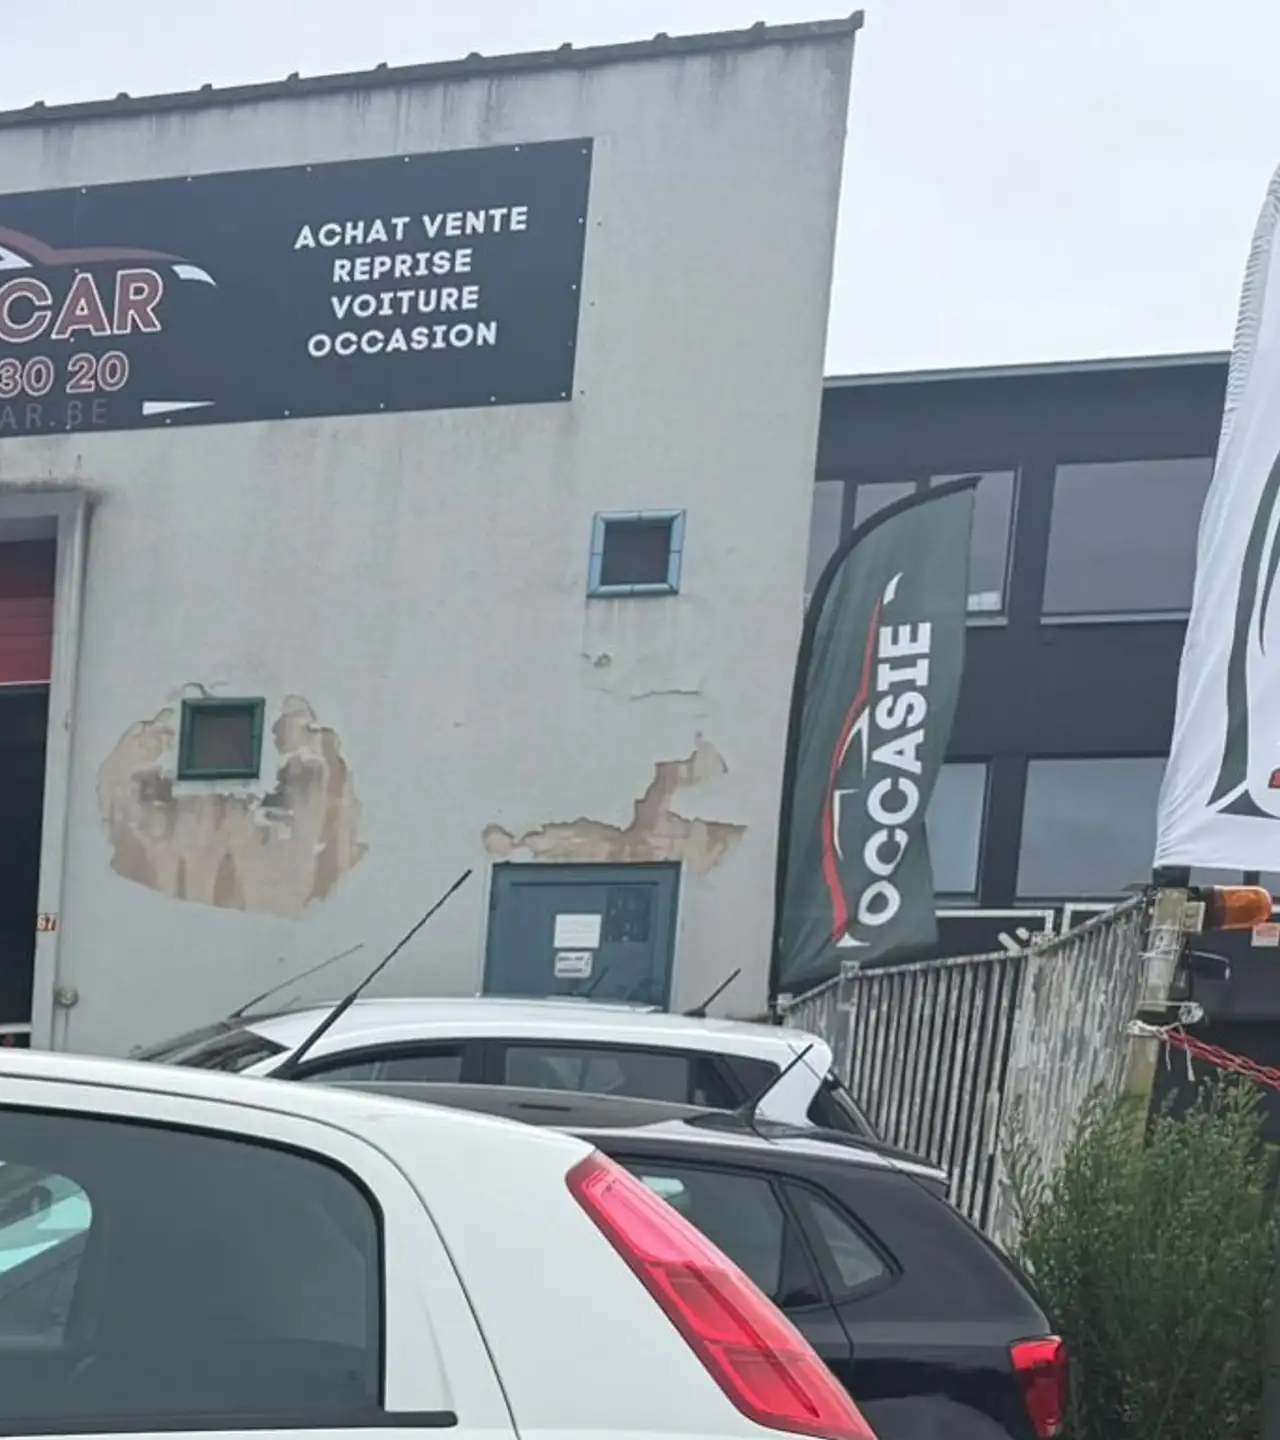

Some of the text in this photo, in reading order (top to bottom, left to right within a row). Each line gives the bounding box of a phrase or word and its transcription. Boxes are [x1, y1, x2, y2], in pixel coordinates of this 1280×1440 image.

[293, 206, 529, 250] ACHAT VENTE
[332, 248, 473, 283] REPRISE
[330, 285, 480, 320] VOITURE
[307, 321, 498, 357] OCCASION
[66, 350, 130, 394] 20
[857, 621, 933, 927] OCCASIE
